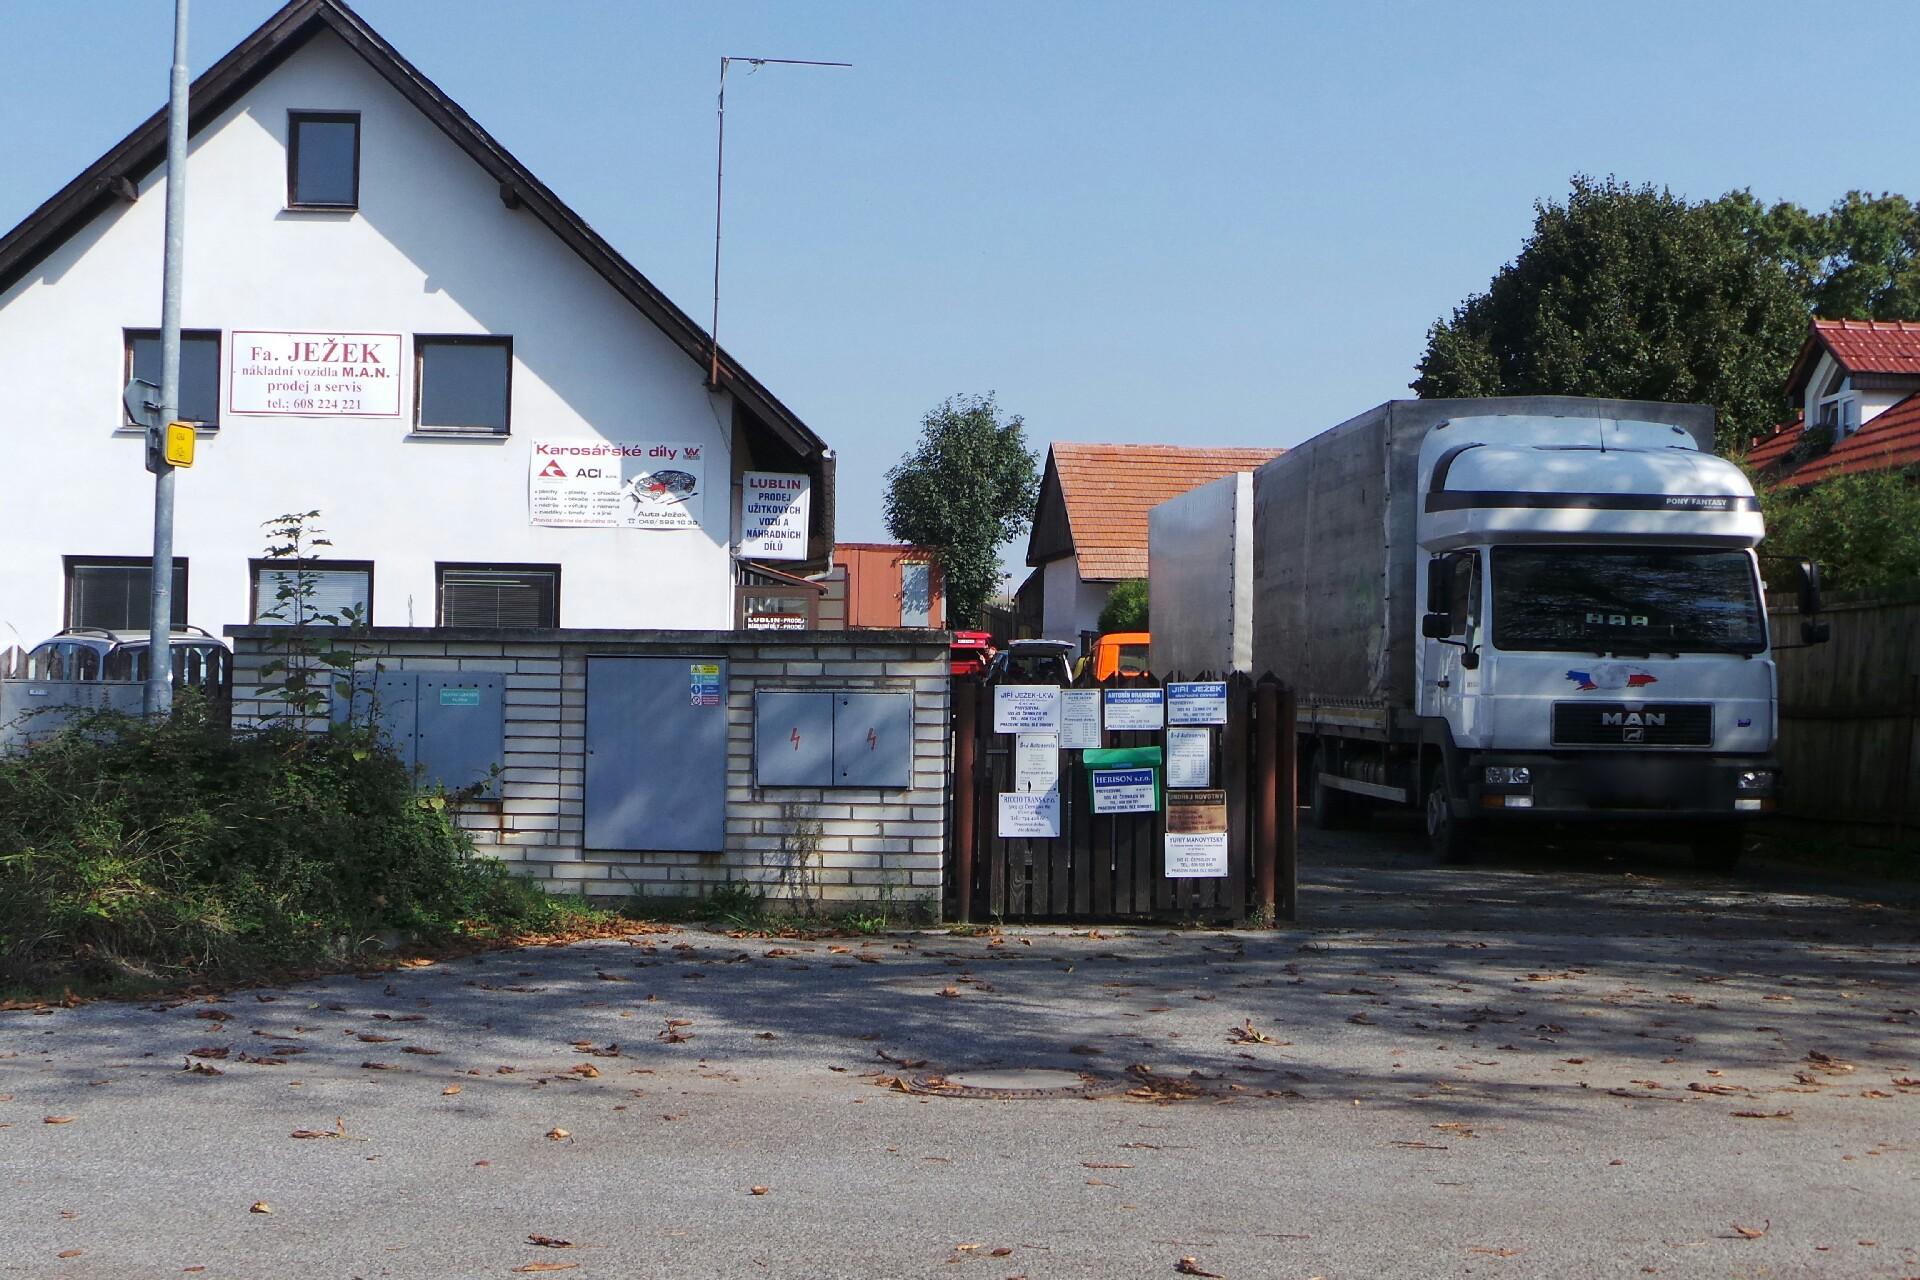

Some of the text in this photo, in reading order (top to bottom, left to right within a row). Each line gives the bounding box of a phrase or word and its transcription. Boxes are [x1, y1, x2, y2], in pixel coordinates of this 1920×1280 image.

[250, 337, 382, 363] Fa. JEŽEK
[242, 364, 390, 379] nákladní vozidla M.A.N.
[267, 380, 309, 394] prodej
[326, 382, 362, 392] servis
[293, 400, 314, 409] 608
[317, 400, 338, 409] 224
[341, 401, 361, 410] 221
[536, 443, 642, 457] Karosářské
[648, 445, 678, 460] díly
[576, 468, 602, 478] ACI
[749, 478, 801, 490] LUBLIN
[758, 492, 791, 502] PRODEJ
[1691, 498, 1728, 506] FANTASY
[748, 502, 801, 515] UŽITKOVÝCH
[661, 511, 687, 519] Ježek
[759, 515, 789, 526] VOZŮ A
[746, 528, 801, 539] NÁHRADNÍCH
[764, 540, 783, 551] DÍLŮ
[1191, 684, 1223, 693] JEŽEK
[1601, 711, 1666, 726] MAN
[1095, 775, 1133, 784] HERISON
